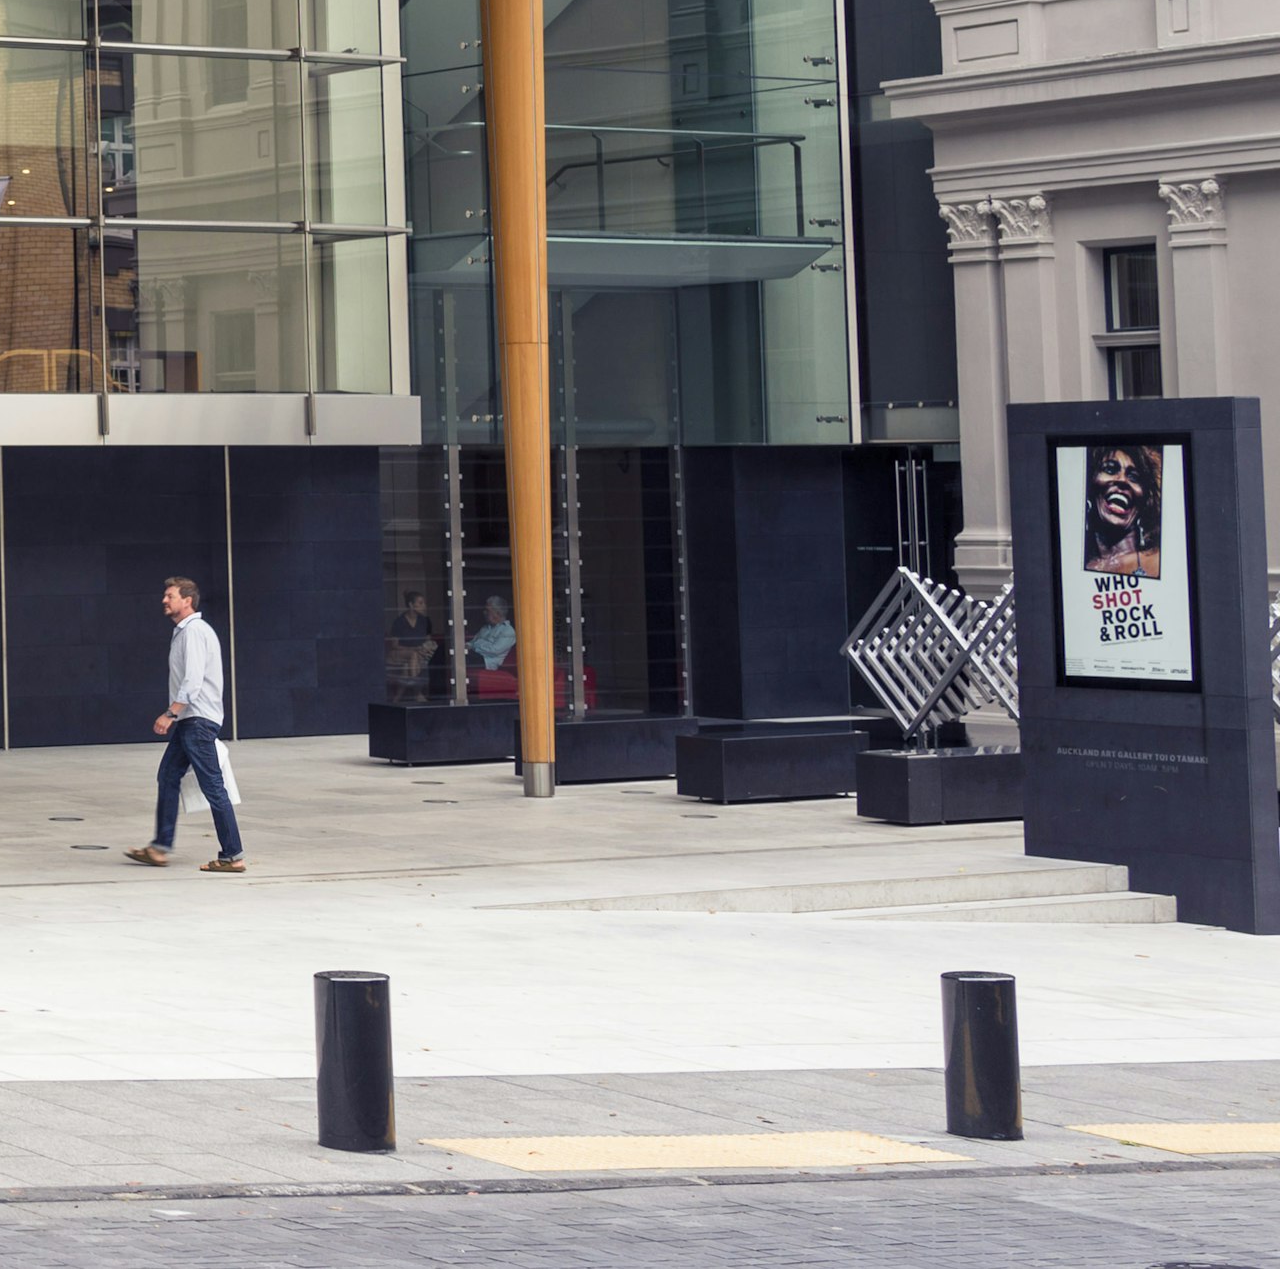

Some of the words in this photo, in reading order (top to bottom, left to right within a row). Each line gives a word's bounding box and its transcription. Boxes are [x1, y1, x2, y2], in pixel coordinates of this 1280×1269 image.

[1094, 574, 1139, 593] WHO
[1092, 589, 1142, 610] SHOT
[1101, 604, 1156, 625] ROCK
[1100, 626, 1112, 642] &
[1114, 620, 1163, 640] ROLL
[1056, 746, 1100, 757] AUCKLAND
[1100, 749, 1116, 758] ART
[1117, 750, 1153, 761] GALLERY
[1154, 753, 1168, 762] TOI
[1169, 754, 1176, 762] O
